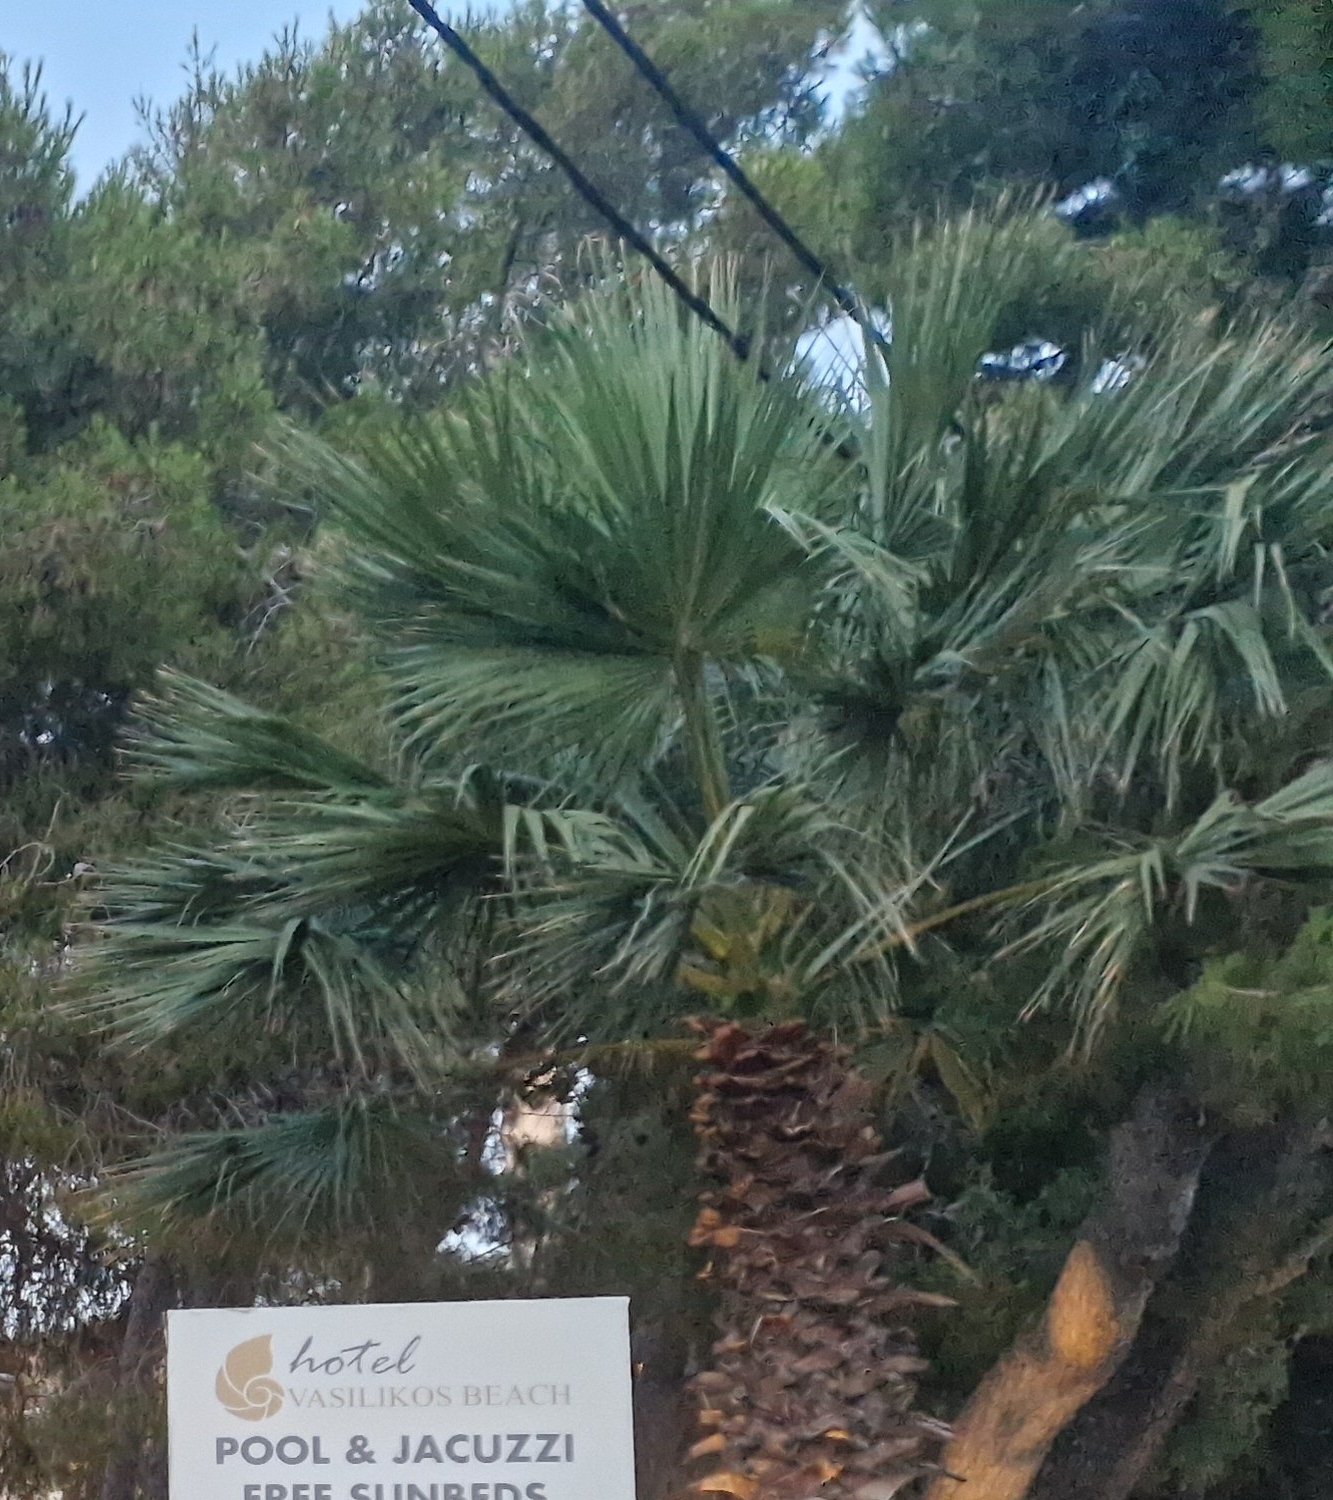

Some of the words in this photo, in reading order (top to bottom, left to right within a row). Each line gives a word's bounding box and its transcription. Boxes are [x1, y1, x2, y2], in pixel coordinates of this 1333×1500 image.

[289, 1335, 422, 1375] hotel
[288, 1386, 453, 1408] VASILIKOS
[462, 1384, 571, 1407] BEACH
[215, 1436, 331, 1466] POOL
[345, 1434, 377, 1465] &
[392, 1433, 575, 1465] JACUZZI
